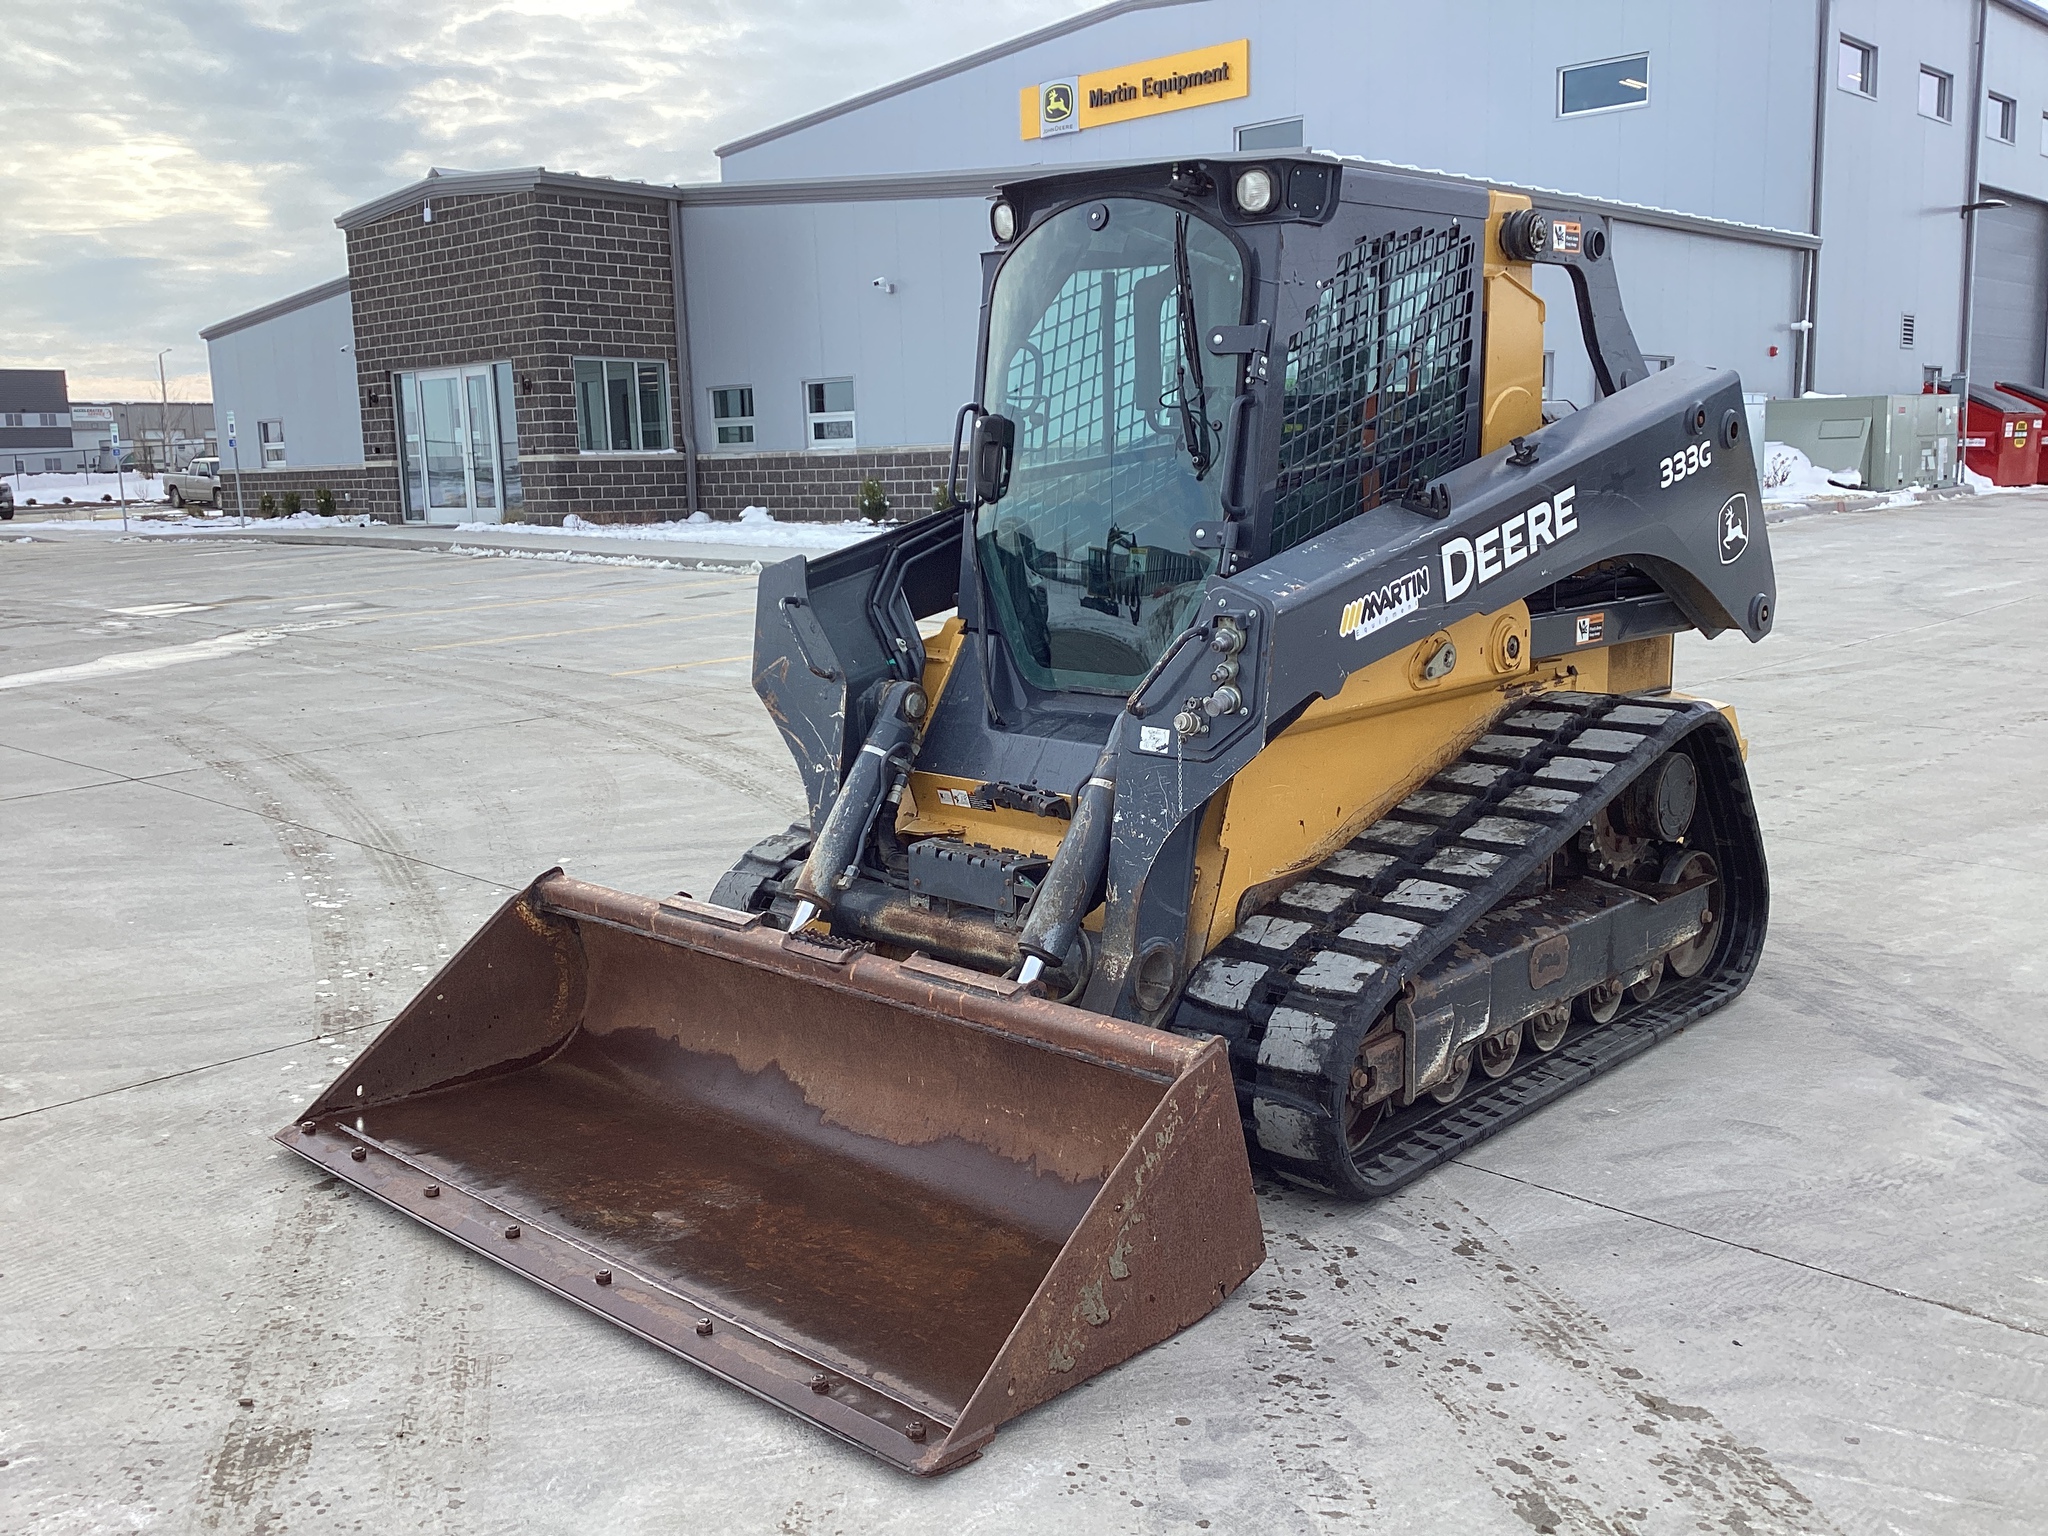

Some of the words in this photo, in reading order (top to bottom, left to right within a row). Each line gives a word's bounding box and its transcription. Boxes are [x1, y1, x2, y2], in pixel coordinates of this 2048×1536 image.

[1089, 82, 1137, 108] Martin
[1142, 62, 1230, 98] Equipment
[1055, 124, 1073, 132] DEERE
[1659, 440, 1712, 489] 333G
[1441, 484, 1578, 603] DEERE
[1360, 567, 1429, 625] MARTIN
